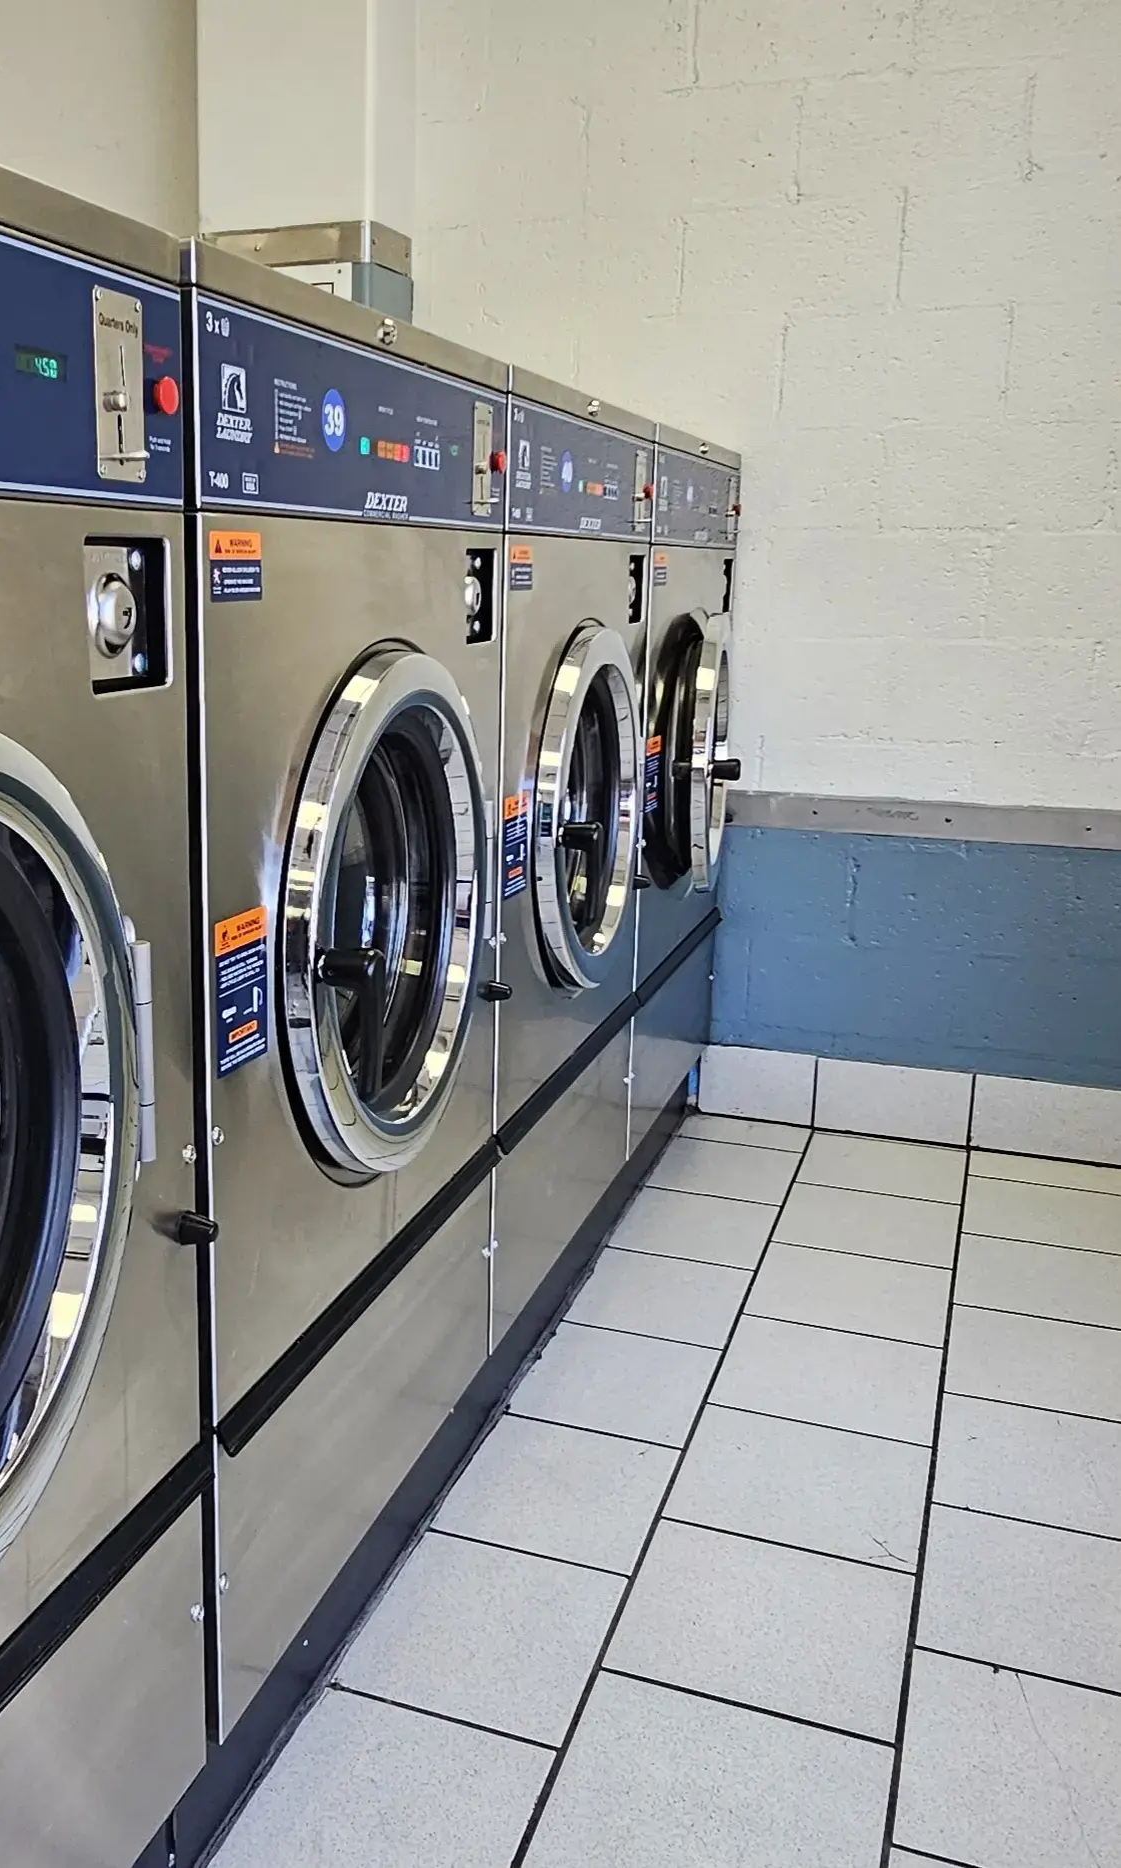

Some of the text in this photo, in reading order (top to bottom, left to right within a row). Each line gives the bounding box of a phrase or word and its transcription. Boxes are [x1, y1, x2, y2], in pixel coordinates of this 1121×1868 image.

[99, 312, 138, 339] Quarters Only
[216, 412, 252, 431] DEXTER
[324, 404, 346, 437] 39
[364, 492, 408, 512] DEXTER
